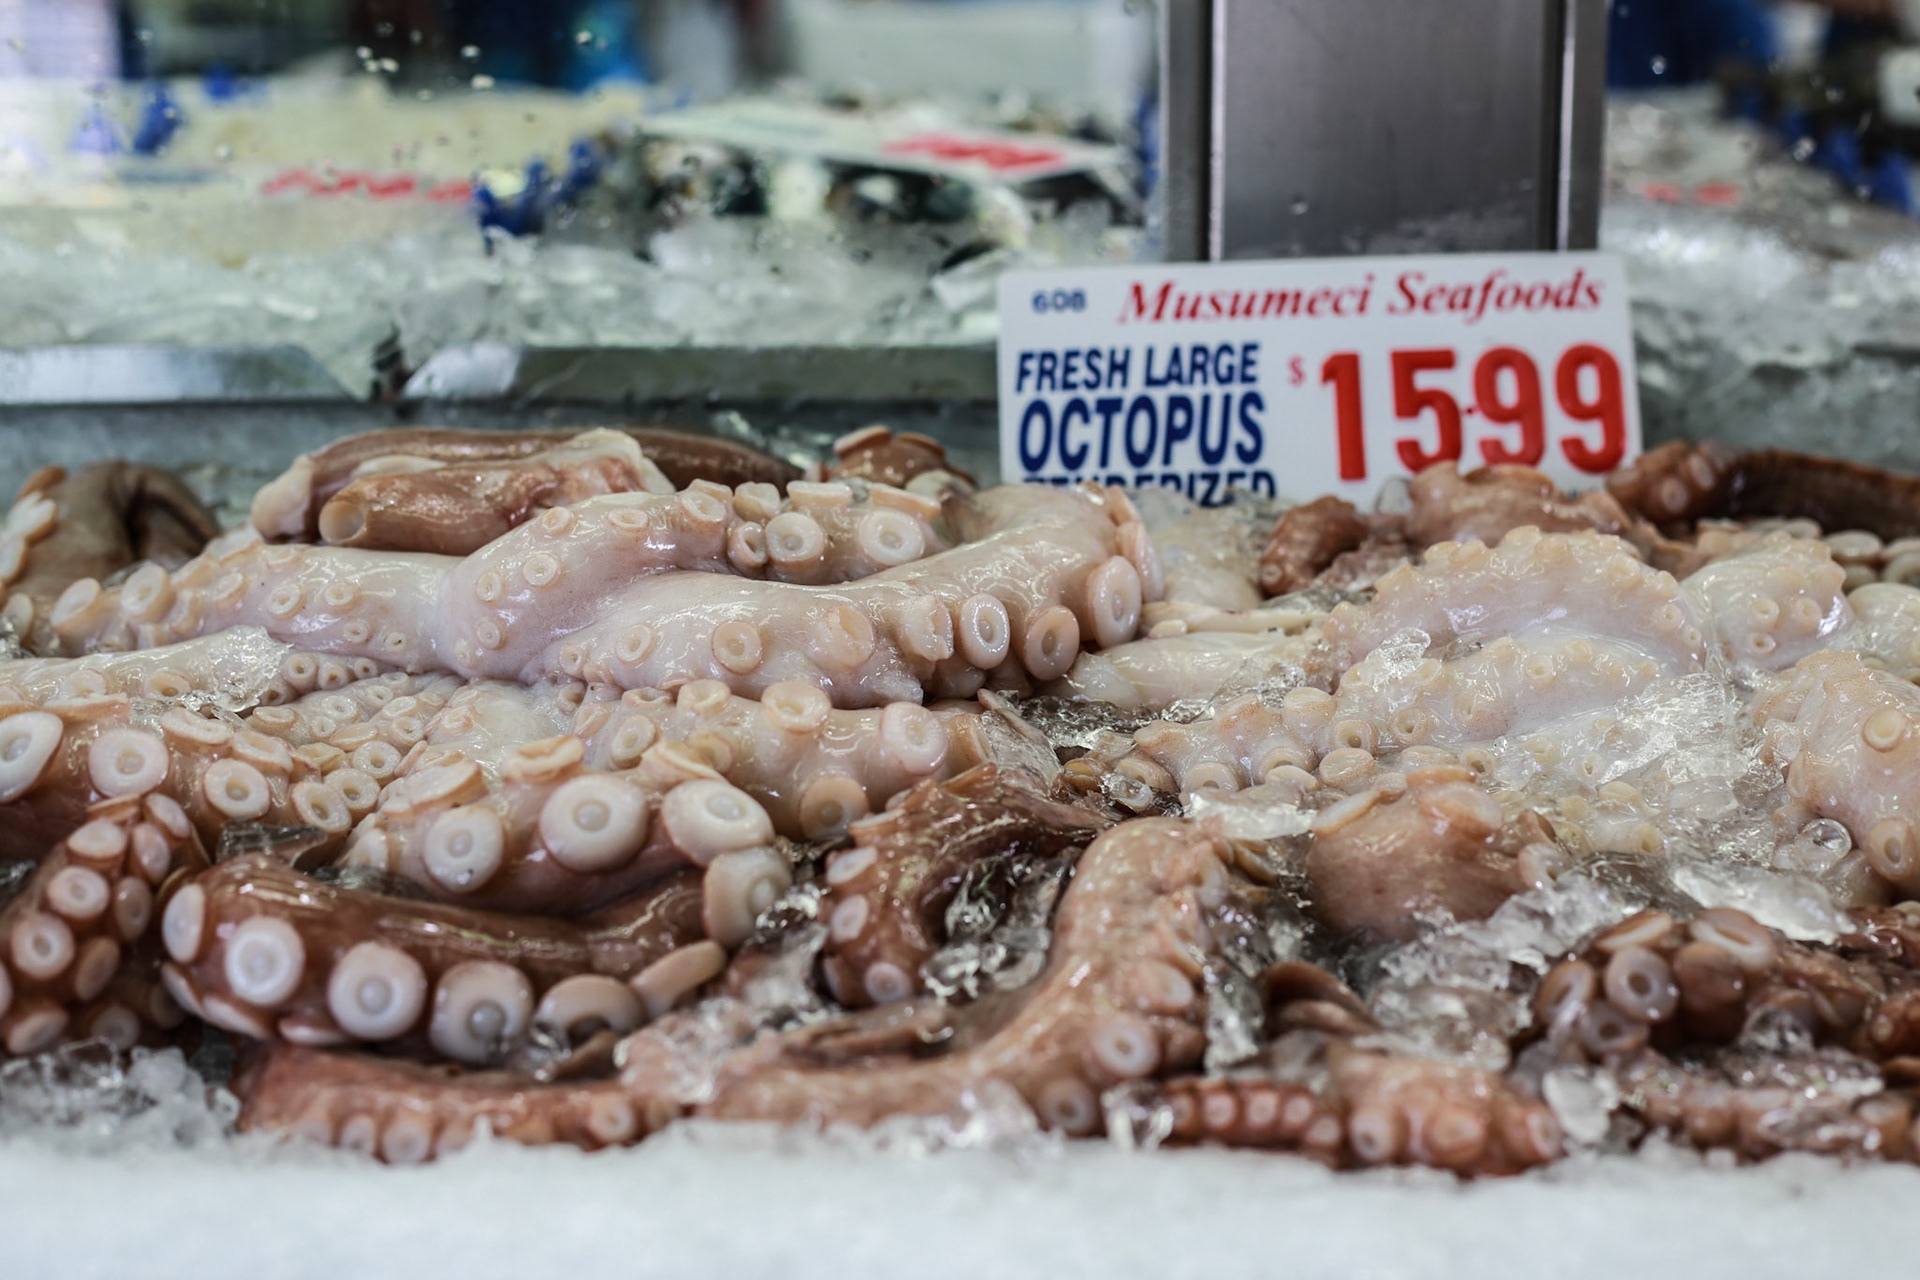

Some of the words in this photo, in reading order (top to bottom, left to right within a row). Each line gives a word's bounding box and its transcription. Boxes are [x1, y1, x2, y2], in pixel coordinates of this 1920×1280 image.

[1032, 288, 1086, 313] 608
[1119, 274, 1375, 324] Musumeci
[1387, 268, 1602, 325] Seafoods
[1016, 347, 1130, 393] FRESH
[1144, 342, 1259, 387] LARGE
[1018, 391, 1265, 472] OCTOPUS
